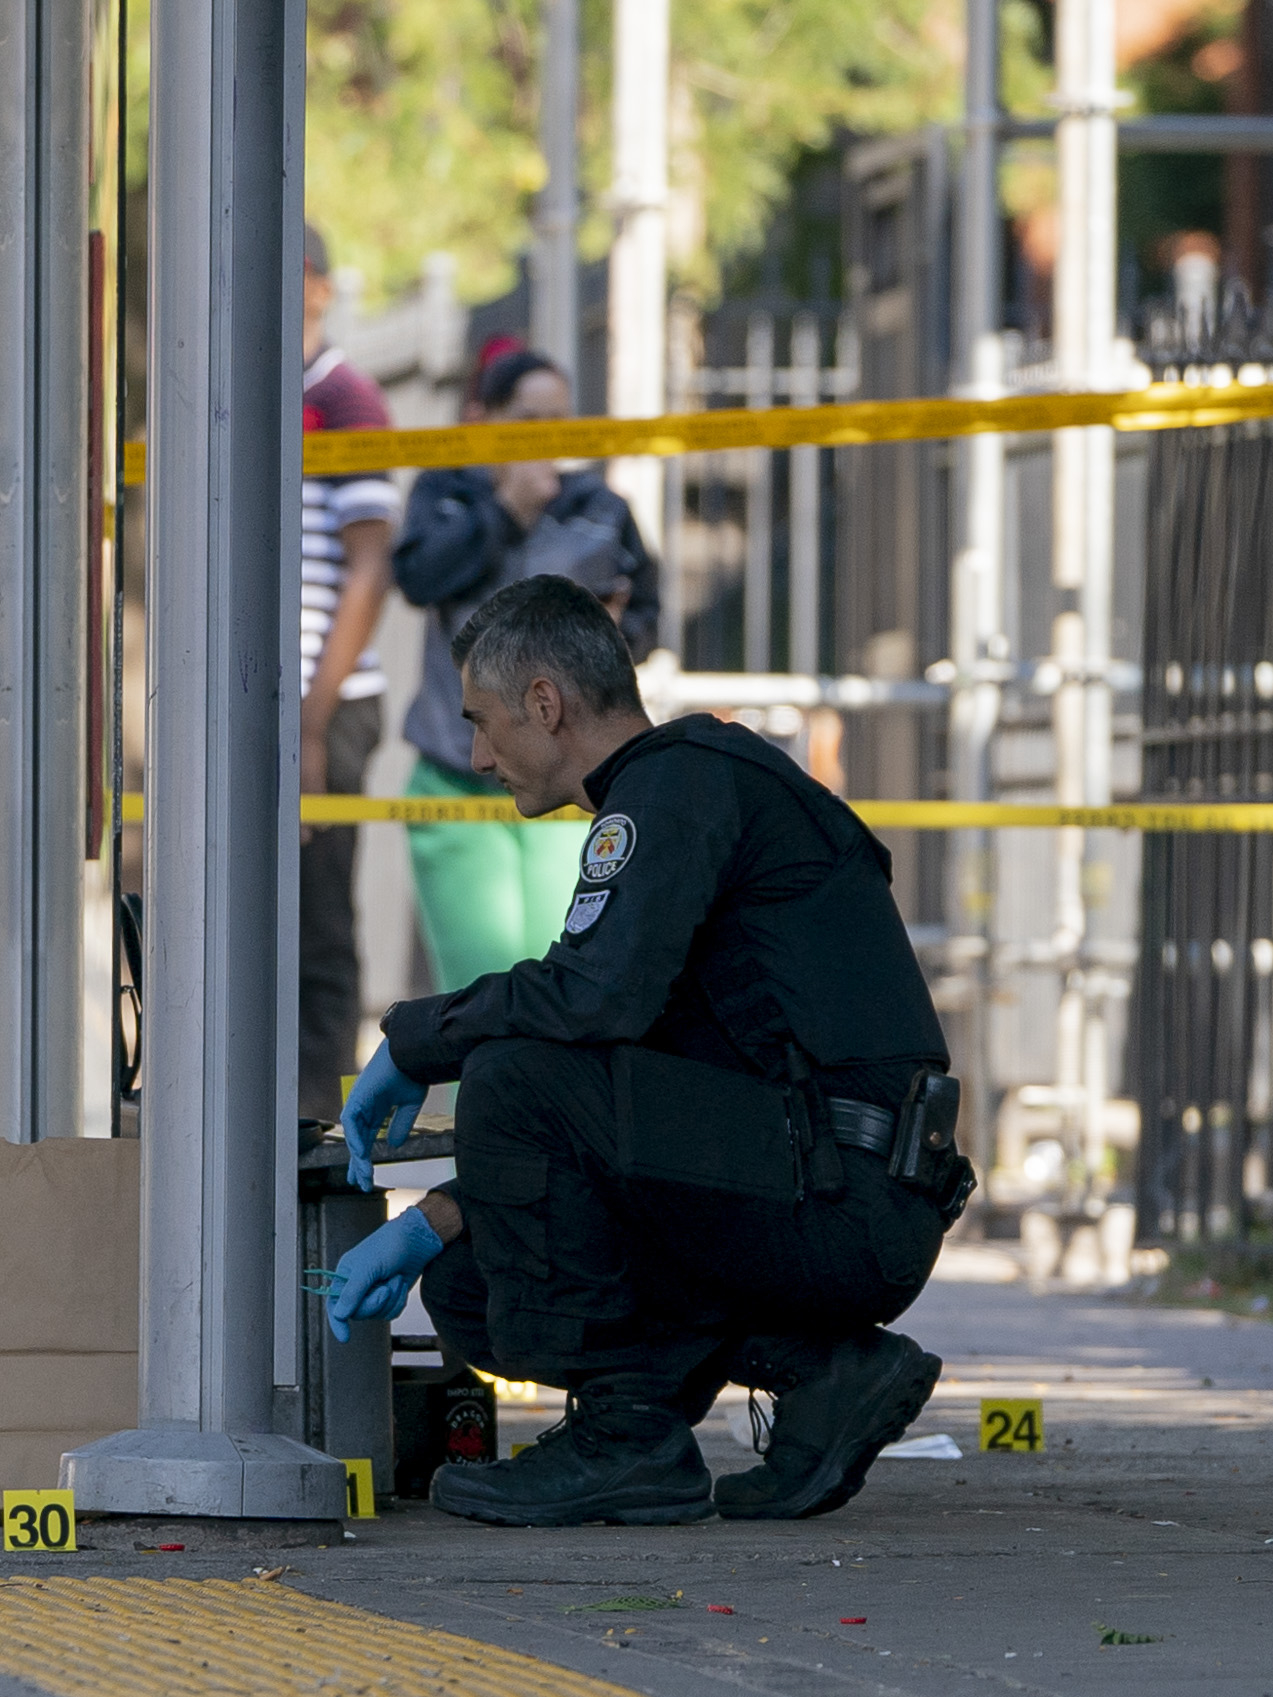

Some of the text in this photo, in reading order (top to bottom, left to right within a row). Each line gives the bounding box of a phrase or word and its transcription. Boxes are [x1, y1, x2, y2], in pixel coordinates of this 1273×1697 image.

[587, 861, 618, 878] POLICE
[986, 1410, 1041, 1451] 24
[8, 1503, 70, 1548] 30
